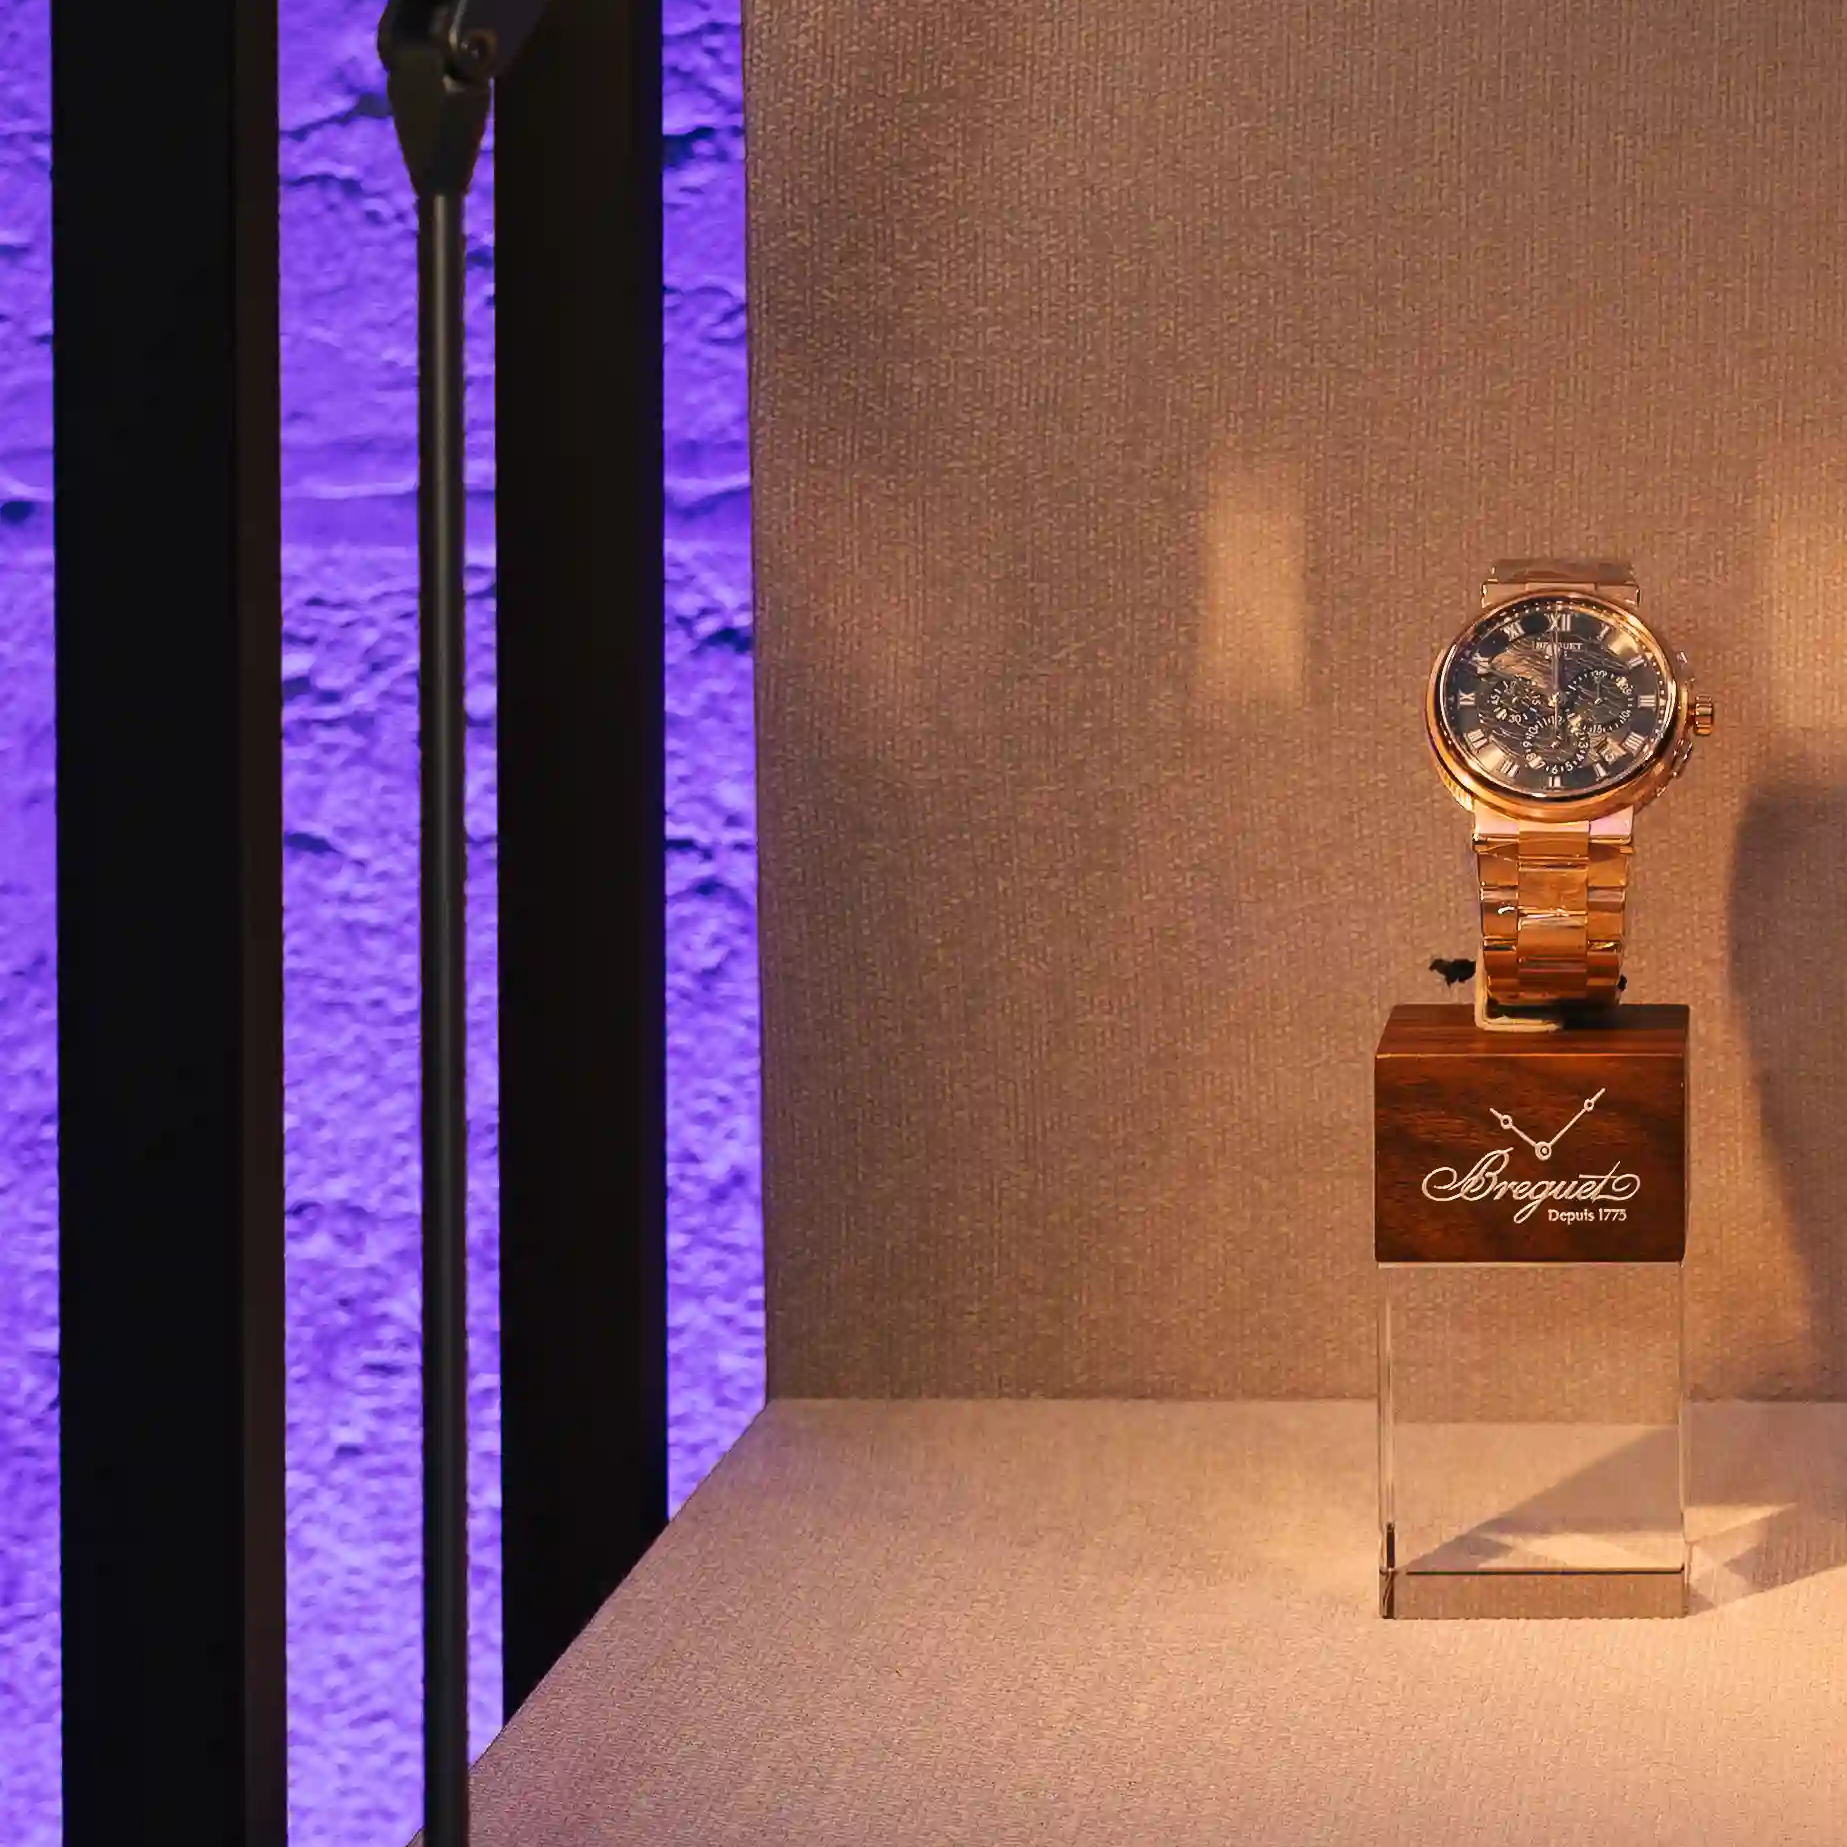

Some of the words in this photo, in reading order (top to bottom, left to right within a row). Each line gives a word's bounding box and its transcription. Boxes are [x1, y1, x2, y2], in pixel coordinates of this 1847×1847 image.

[1421, 1147, 1641, 1224] Breguet
[1548, 1208, 1595, 1225] Depuis
[1598, 1208, 1627, 1222] 1775
